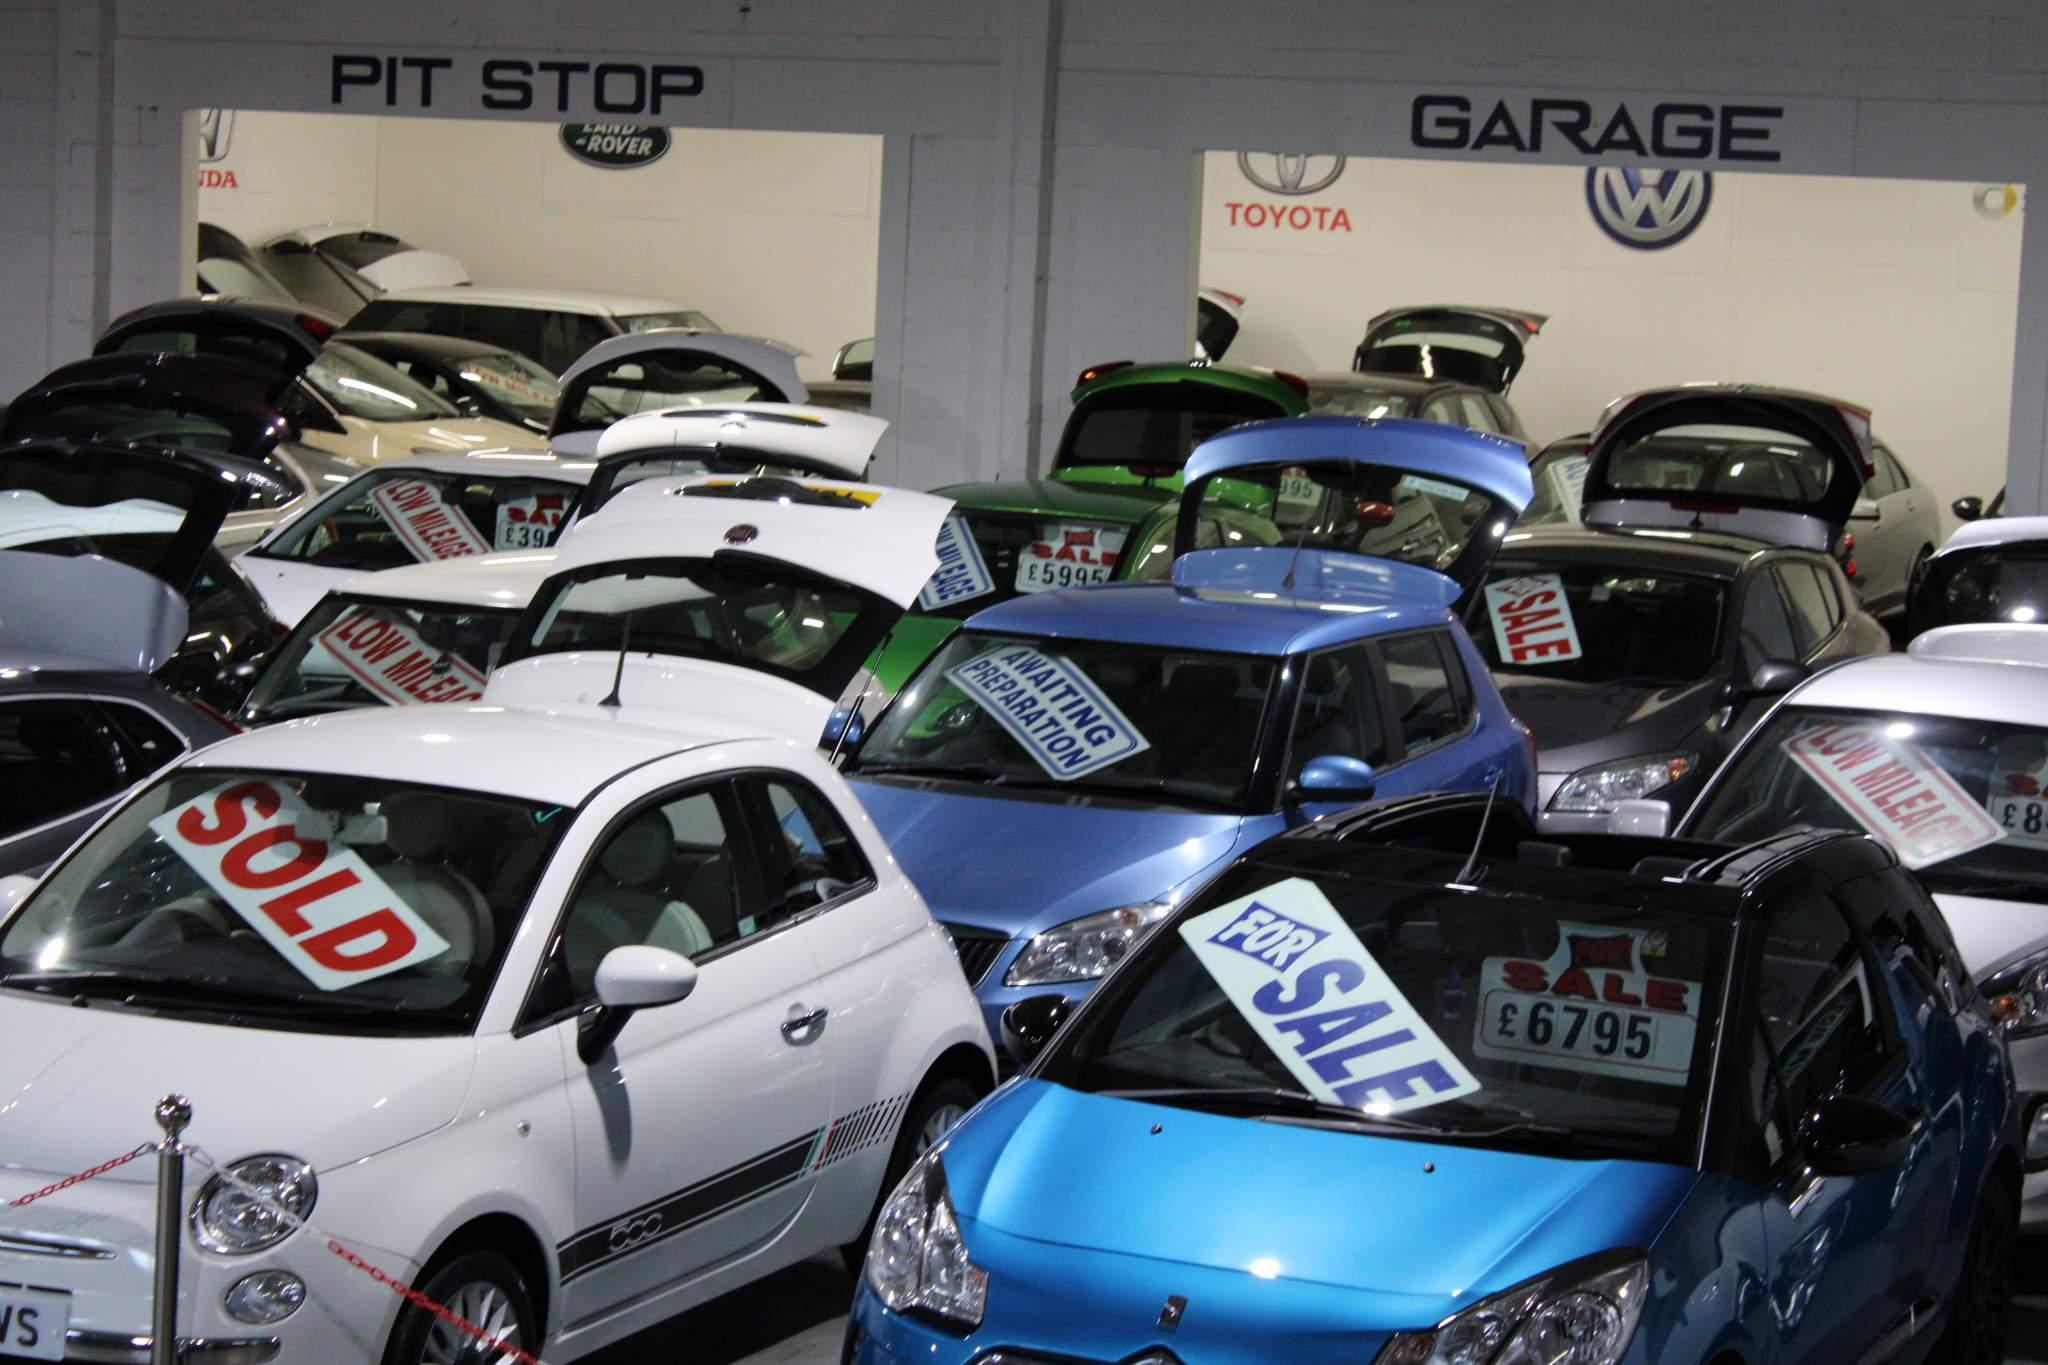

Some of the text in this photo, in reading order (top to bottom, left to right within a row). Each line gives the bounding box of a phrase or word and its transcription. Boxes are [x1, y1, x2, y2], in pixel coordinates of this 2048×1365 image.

[331, 55, 704, 115] PIT STOP
[586, 135, 654, 155] ROVER
[1411, 94, 1784, 162] GARAGE
[1225, 203, 1352, 232] TOYOTA
[386, 480, 432, 512] LOW
[505, 526, 554, 548] £39
[1028, 562, 1104, 587] £5995
[1498, 590, 1572, 663] SALE
[337, 608, 482, 703] LOW MILEA
[962, 659, 1091, 769] PREPARATION
[1001, 650, 1116, 748] AWAITING
[1809, 724, 1889, 772] LOW
[2003, 803, 2048, 834] £8
[177, 781, 416, 972] SOLD
[1218, 908, 1316, 967] FOR
[1502, 961, 1688, 1013] SALE
[1253, 958, 1460, 1106] SALE
[1498, 1002, 1653, 1059] £6795
[609, 1213, 662, 1251] 500
